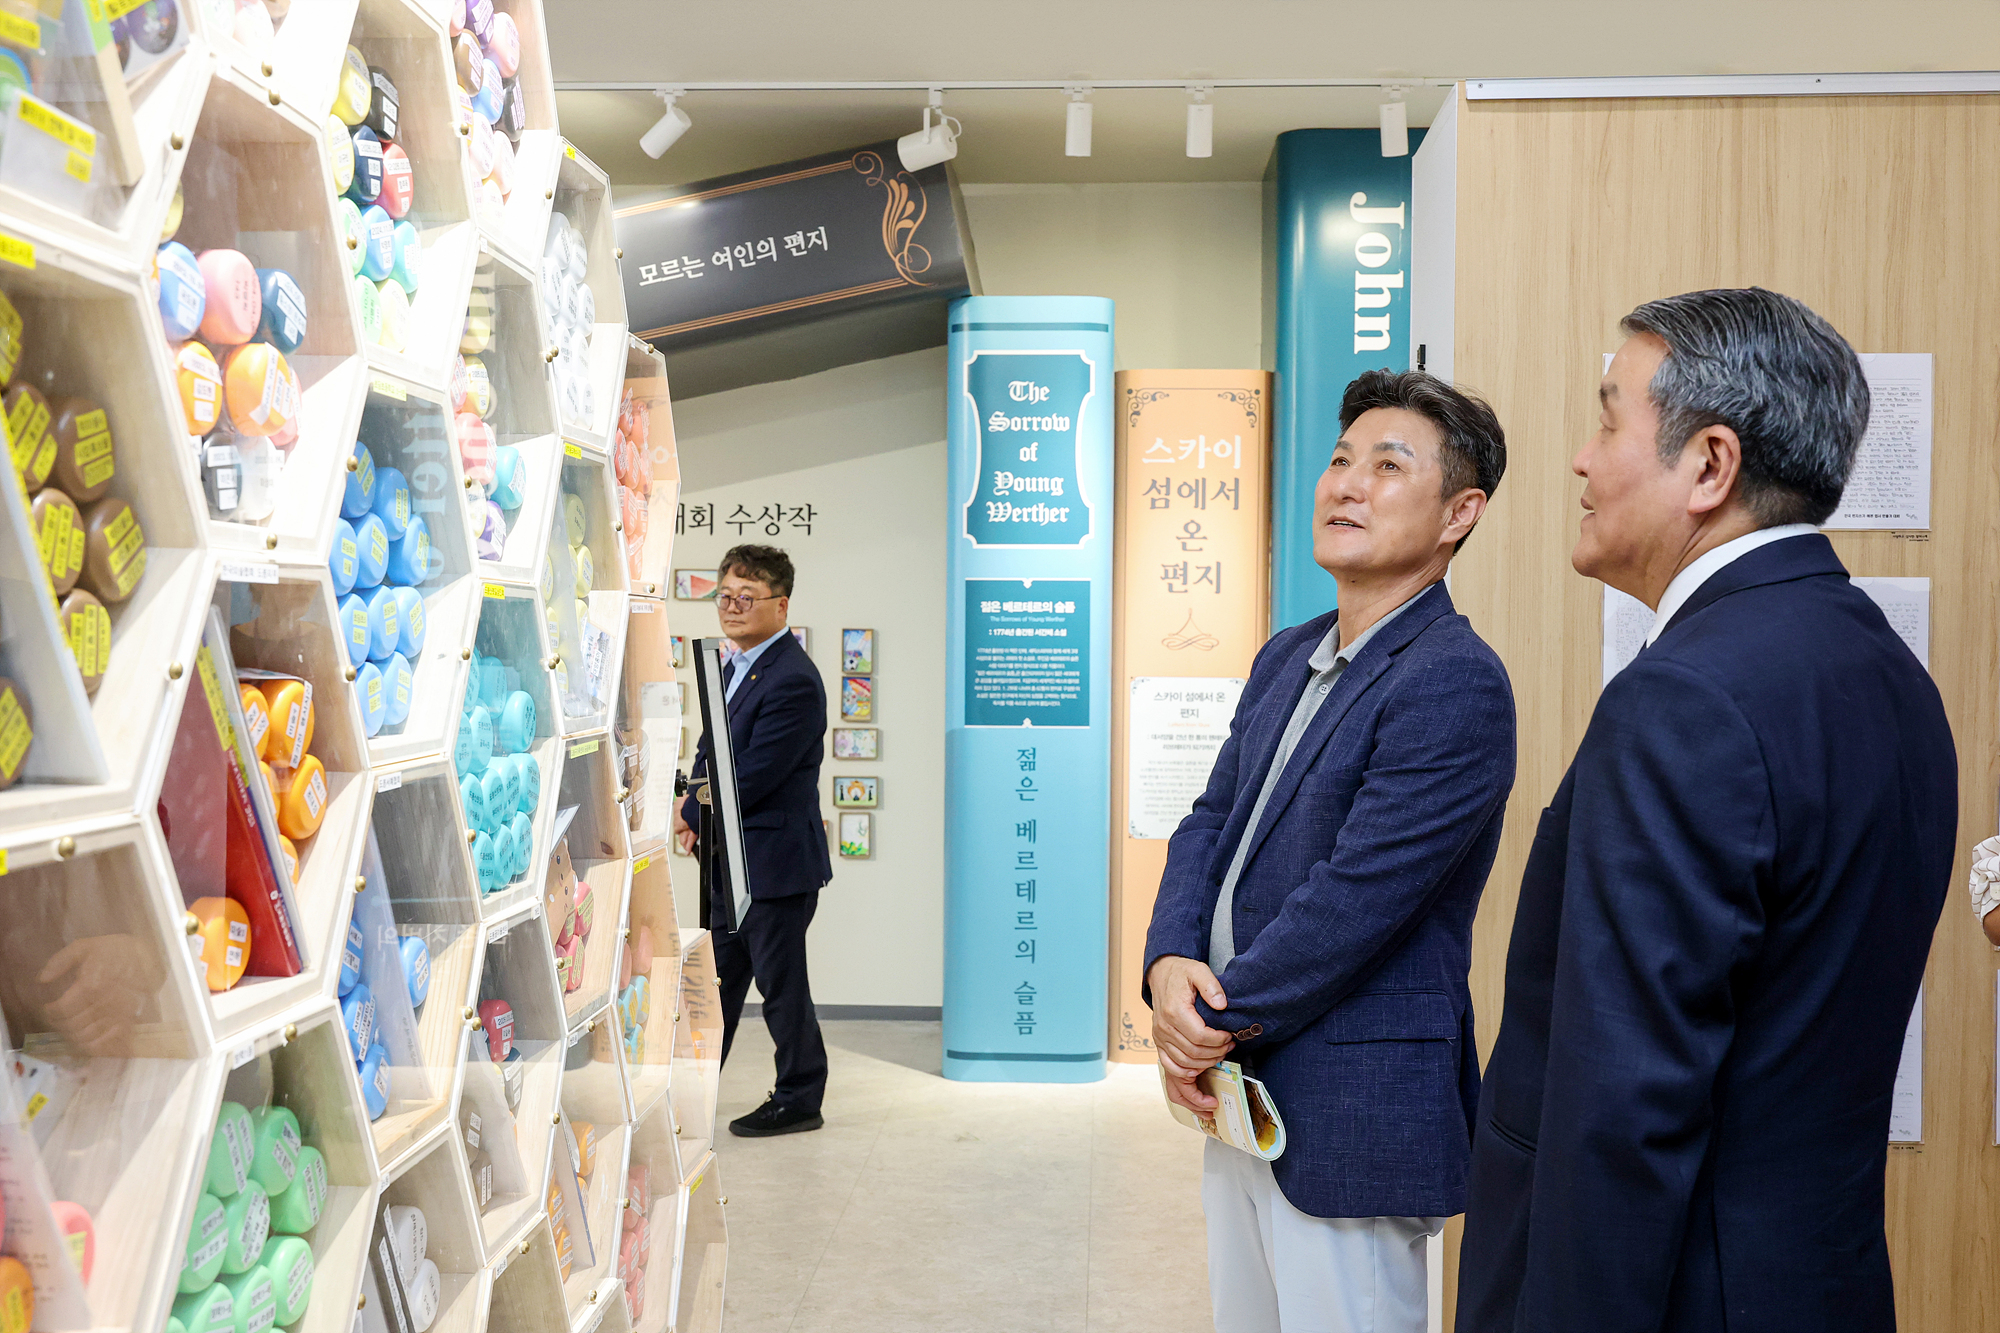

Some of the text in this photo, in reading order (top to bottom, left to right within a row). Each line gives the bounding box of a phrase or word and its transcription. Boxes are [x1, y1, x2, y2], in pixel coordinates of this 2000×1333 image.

[639, 226, 828, 287] 모르는 여인의 편지
[1350, 191, 1405, 354] John
[1008, 380, 1050, 405] The
[988, 411, 1070, 432] Sorrow
[1019, 442, 1038, 462] of
[1142, 435, 1242, 469] 스카이
[993, 471, 1064, 496] Young
[1143, 477, 1240, 510] 섬에서
[725, 503, 818, 536] 수상작
[986, 502, 1070, 526] Werther
[1176, 520, 1207, 552] 온
[1161, 561, 1221, 594] 편지
[981, 600, 1076, 613] 젊은 베르테르의 슬픔
[1154, 692, 1226, 702] 스카이 섬에서 온
[1180, 708, 1199, 718] 편지
[1014, 747, 1039, 1036] 젊은 베르테르의 슬픔
